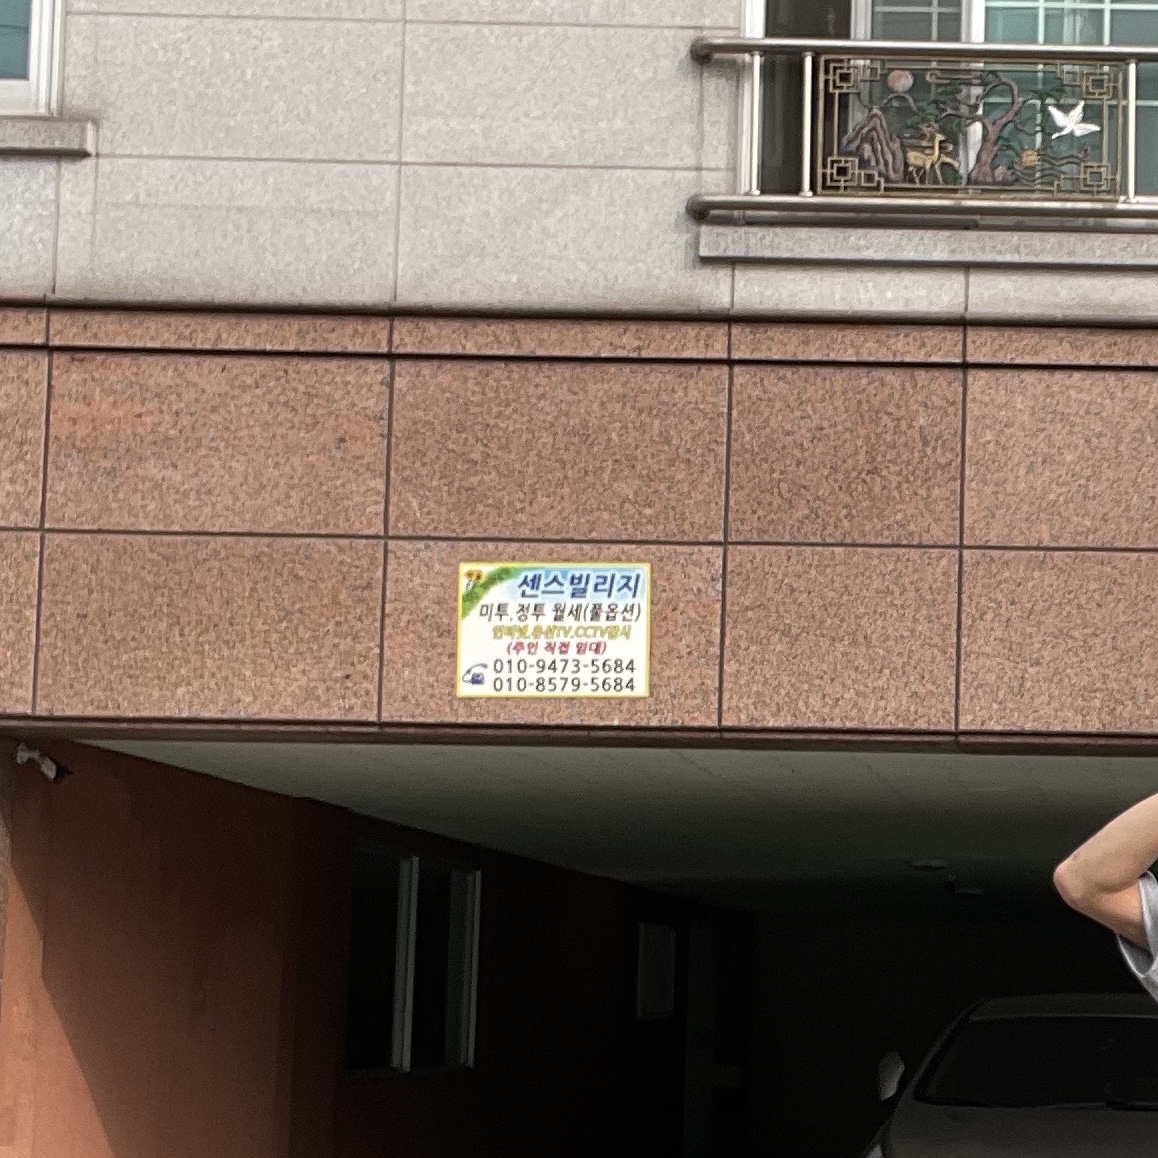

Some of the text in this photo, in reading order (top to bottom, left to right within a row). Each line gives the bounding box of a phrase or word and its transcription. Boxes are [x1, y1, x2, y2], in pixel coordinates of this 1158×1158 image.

[517, 572, 641, 599] 센스빌리지
[552, 602, 642, 623] 월세(풀옵션)
[493, 658, 636, 675] 010-9473-5684
[493, 676, 636, 693] 010-8579-5684
